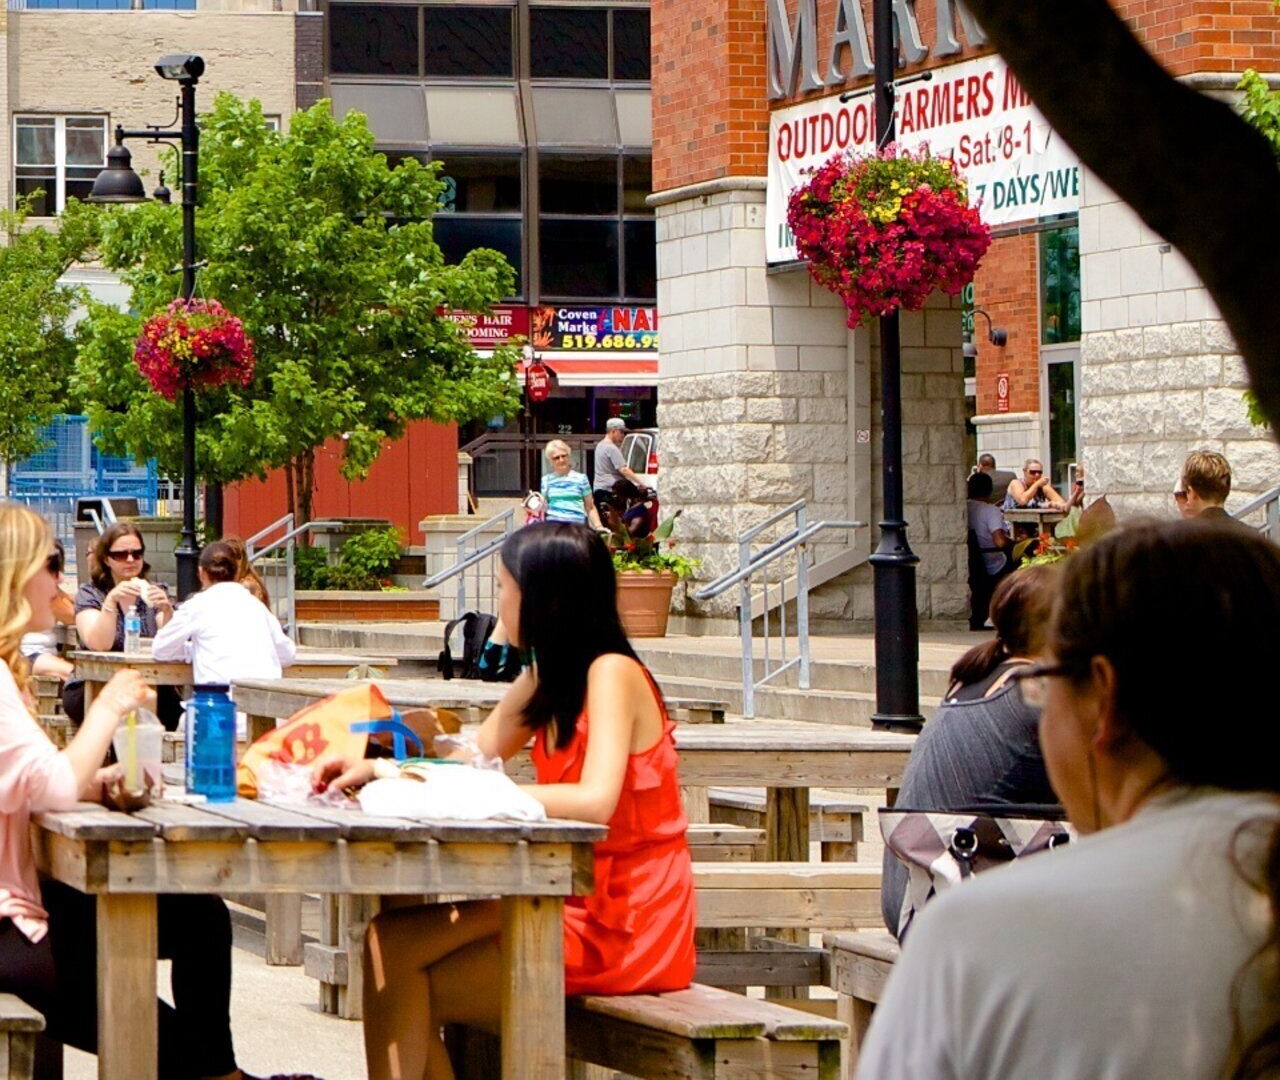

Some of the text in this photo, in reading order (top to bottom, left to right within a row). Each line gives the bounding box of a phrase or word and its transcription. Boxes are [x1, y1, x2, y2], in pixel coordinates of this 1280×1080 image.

[777, 102, 876, 163] OUTDOO
[959, 132, 996, 169] Sat.
[483, 314, 513, 326] HAIR
[455, 327, 509, 338] OOMING
